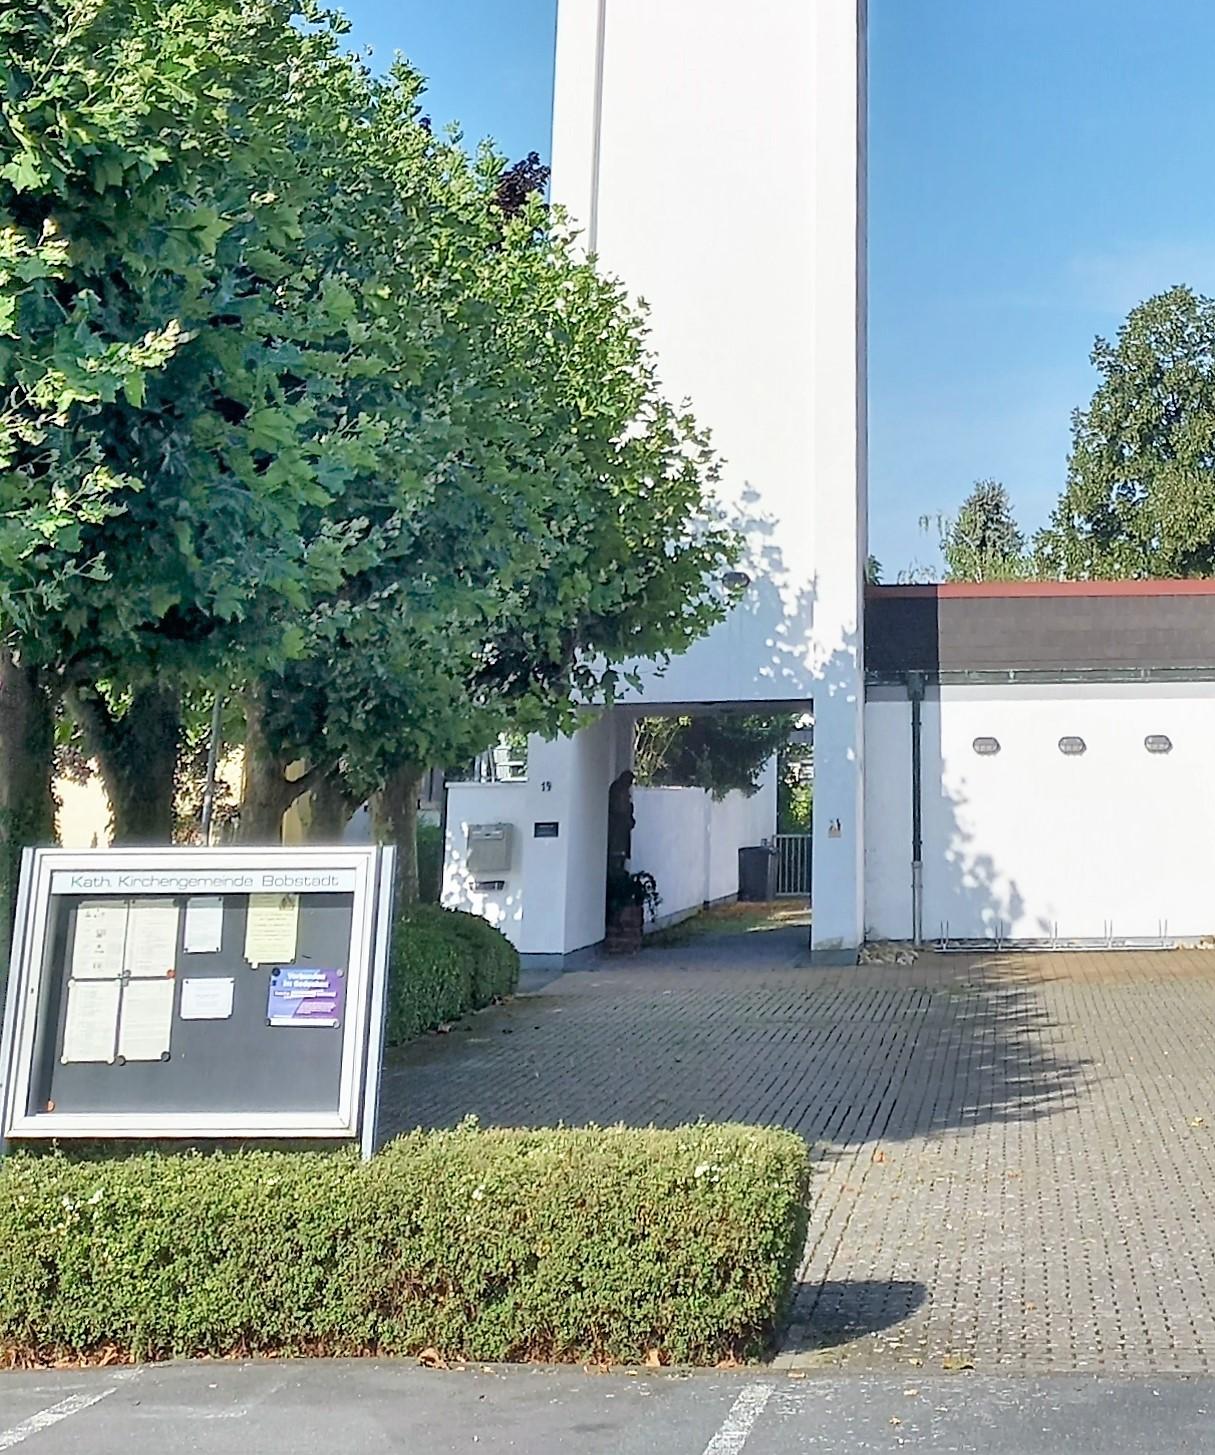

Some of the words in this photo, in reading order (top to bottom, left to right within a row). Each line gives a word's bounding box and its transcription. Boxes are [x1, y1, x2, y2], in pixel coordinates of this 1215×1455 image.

[541, 780, 552, 792] 19
[119, 875, 253, 891] Kirchengemeinde
[262, 875, 339, 887] Bobstadt
